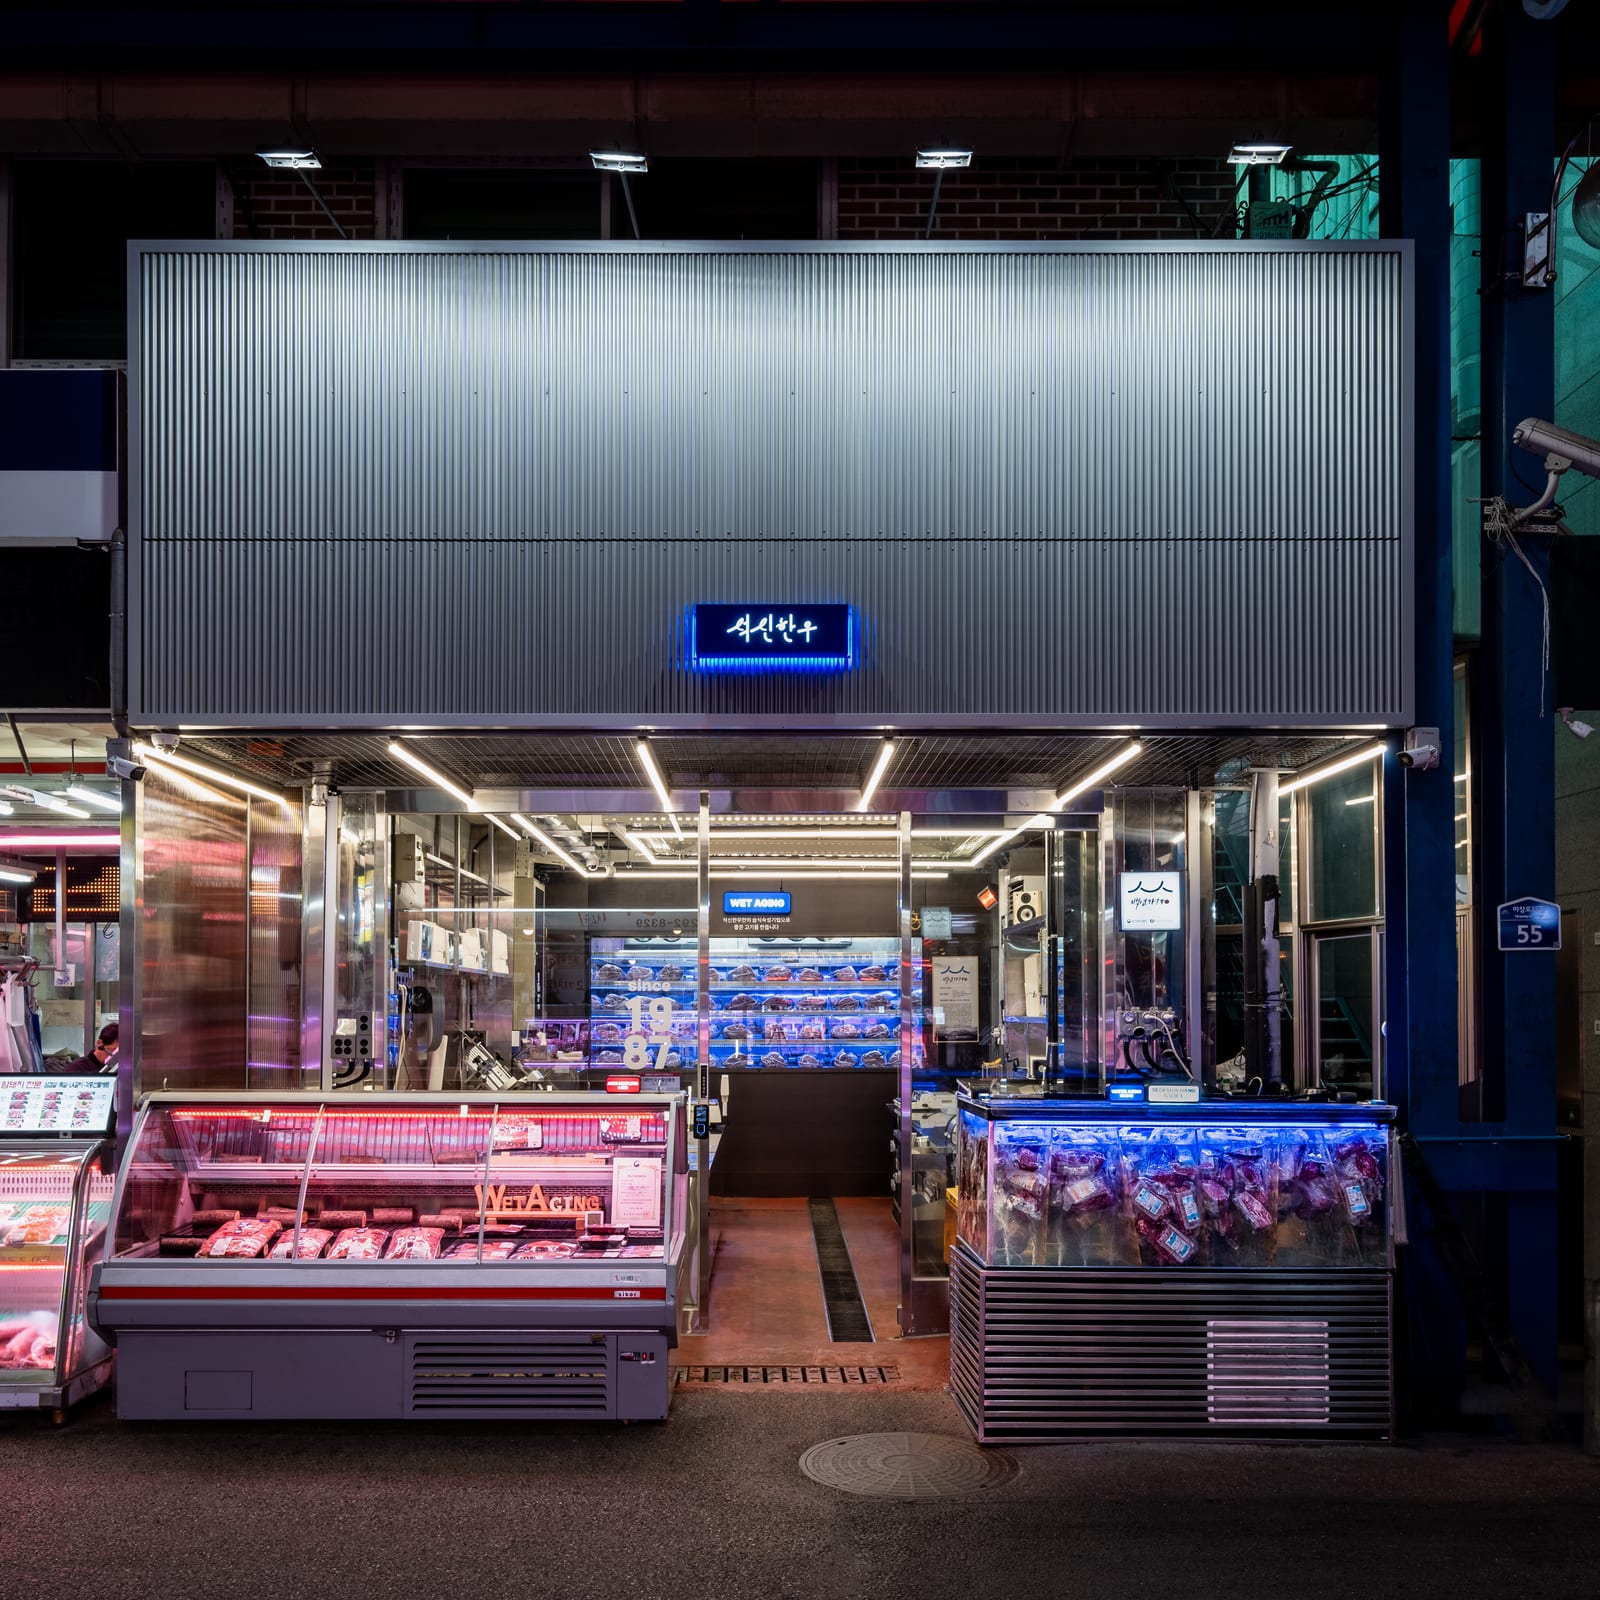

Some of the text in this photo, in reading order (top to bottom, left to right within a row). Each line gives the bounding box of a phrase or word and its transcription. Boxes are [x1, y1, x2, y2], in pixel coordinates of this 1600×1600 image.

[726, 613, 818, 643] 석신한우
[729, 898, 752, 908] WET
[1517, 925, 1543, 943] 55
[628, 979, 671, 991] since
